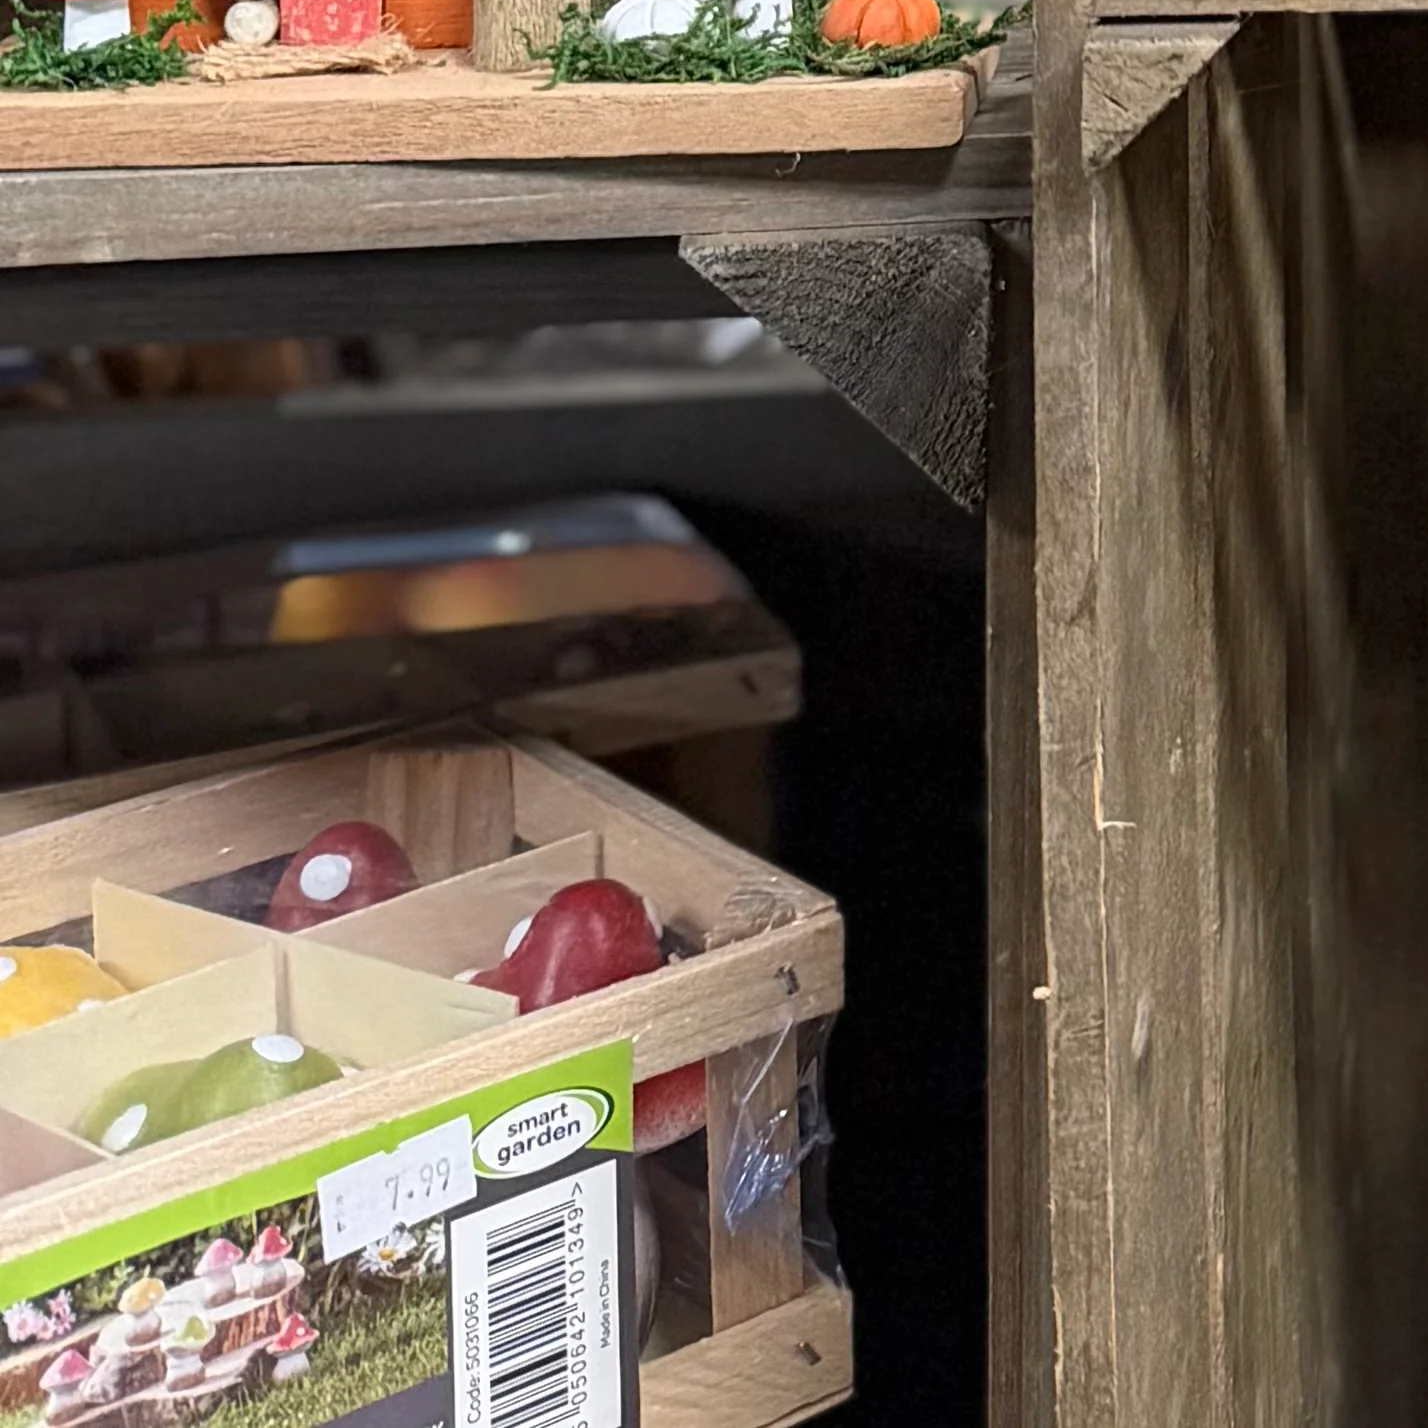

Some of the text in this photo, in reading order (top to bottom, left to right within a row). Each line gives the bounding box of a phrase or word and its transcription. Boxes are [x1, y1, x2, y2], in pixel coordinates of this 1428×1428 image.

[507, 1101, 569, 1138] smart
[496, 1119, 582, 1167] garden
[385, 1156, 451, 1211] 7.99
[599, 1259, 610, 1297] China
